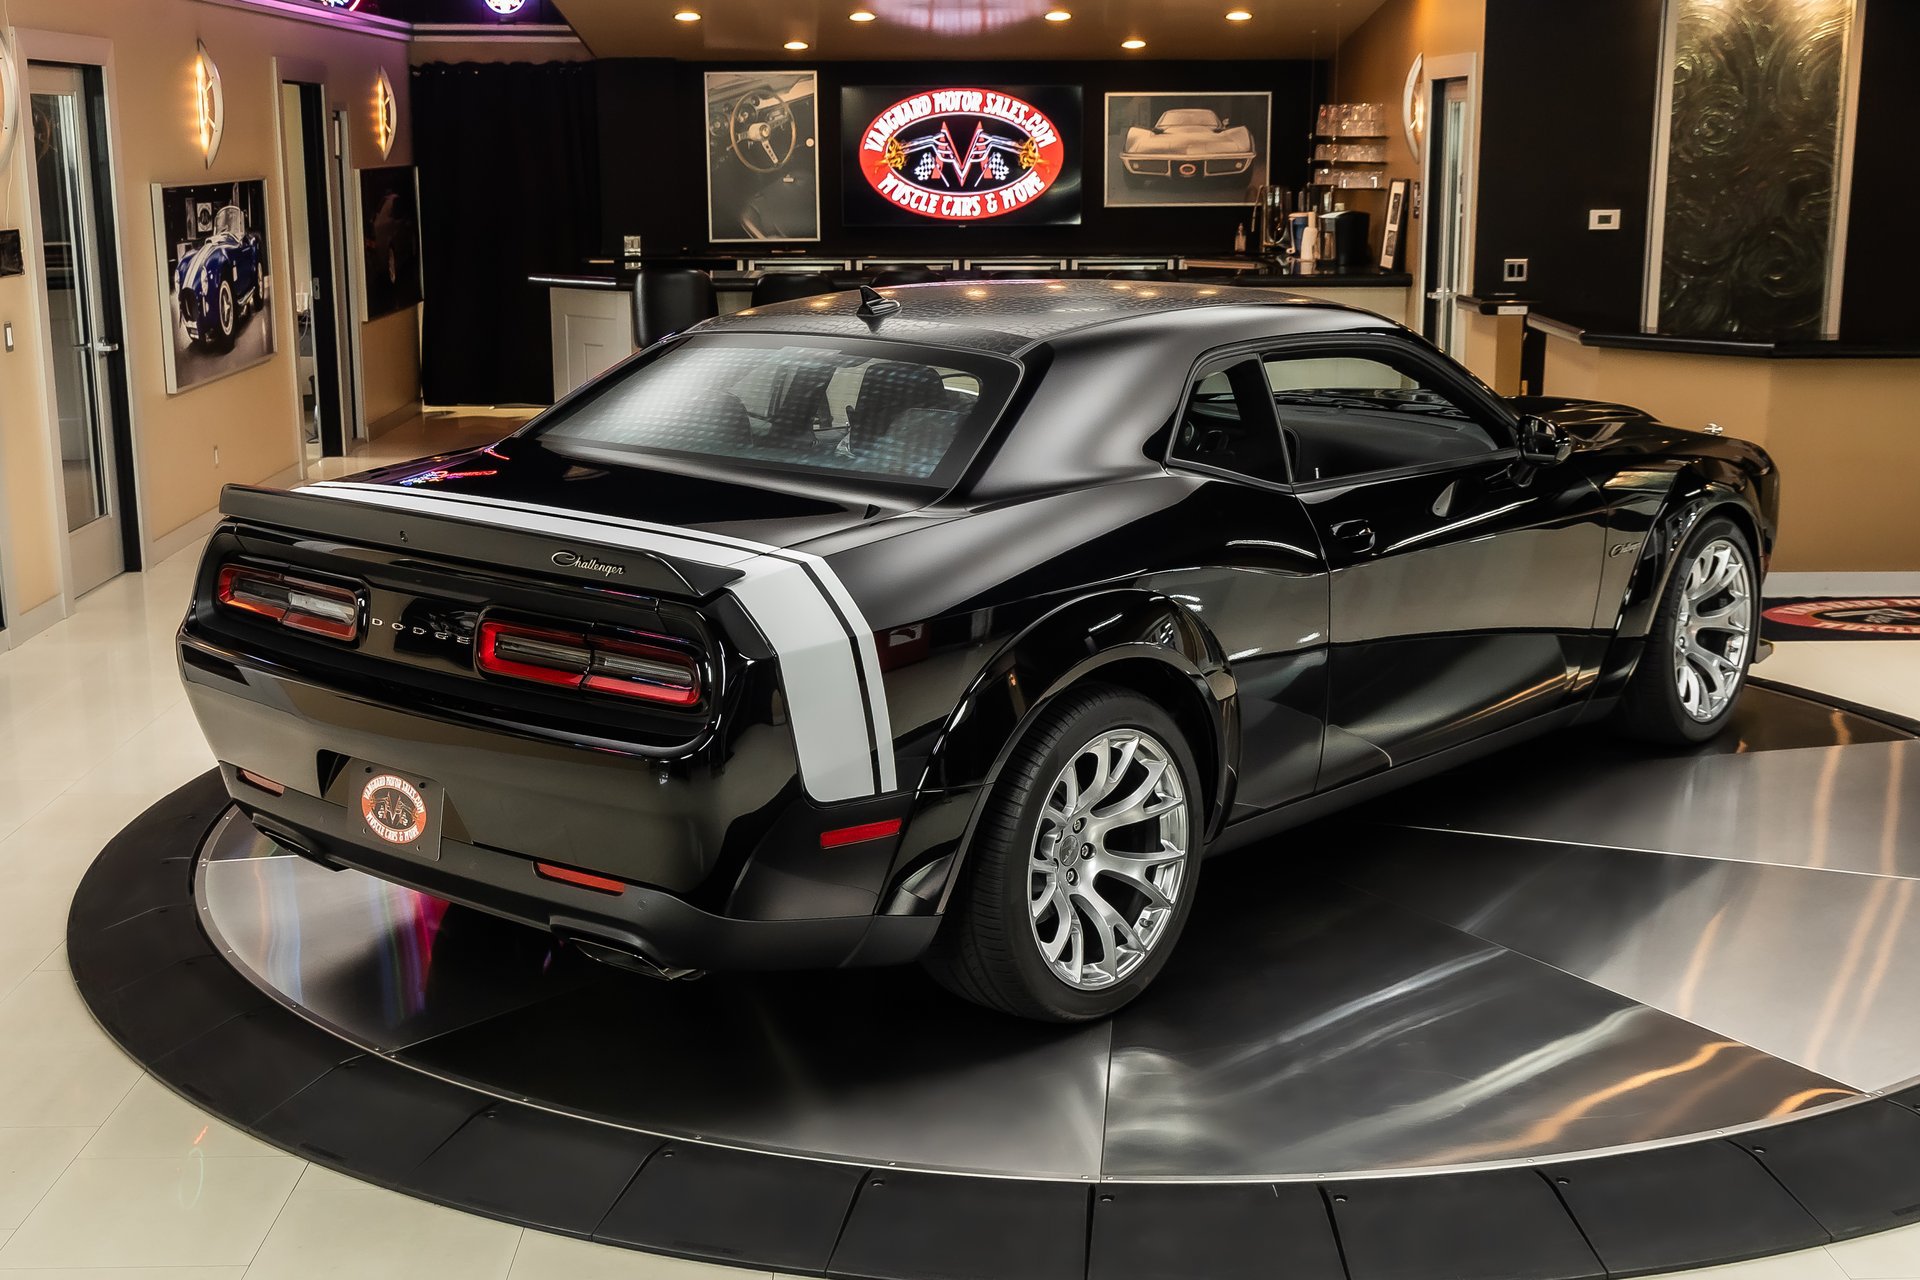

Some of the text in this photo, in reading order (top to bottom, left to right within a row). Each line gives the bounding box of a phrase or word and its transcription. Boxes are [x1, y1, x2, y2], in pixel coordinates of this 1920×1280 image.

[864, 91, 1057, 152] VANGUARD MOTOR SALES.COM
[877, 171, 1045, 217] MUSCLE CARS & MORE
[551, 551, 624, 576] Challenger
[371, 618, 472, 645] DODGE
[365, 811, 384, 837] MUSCLE
[384, 830, 398, 842] CARS
